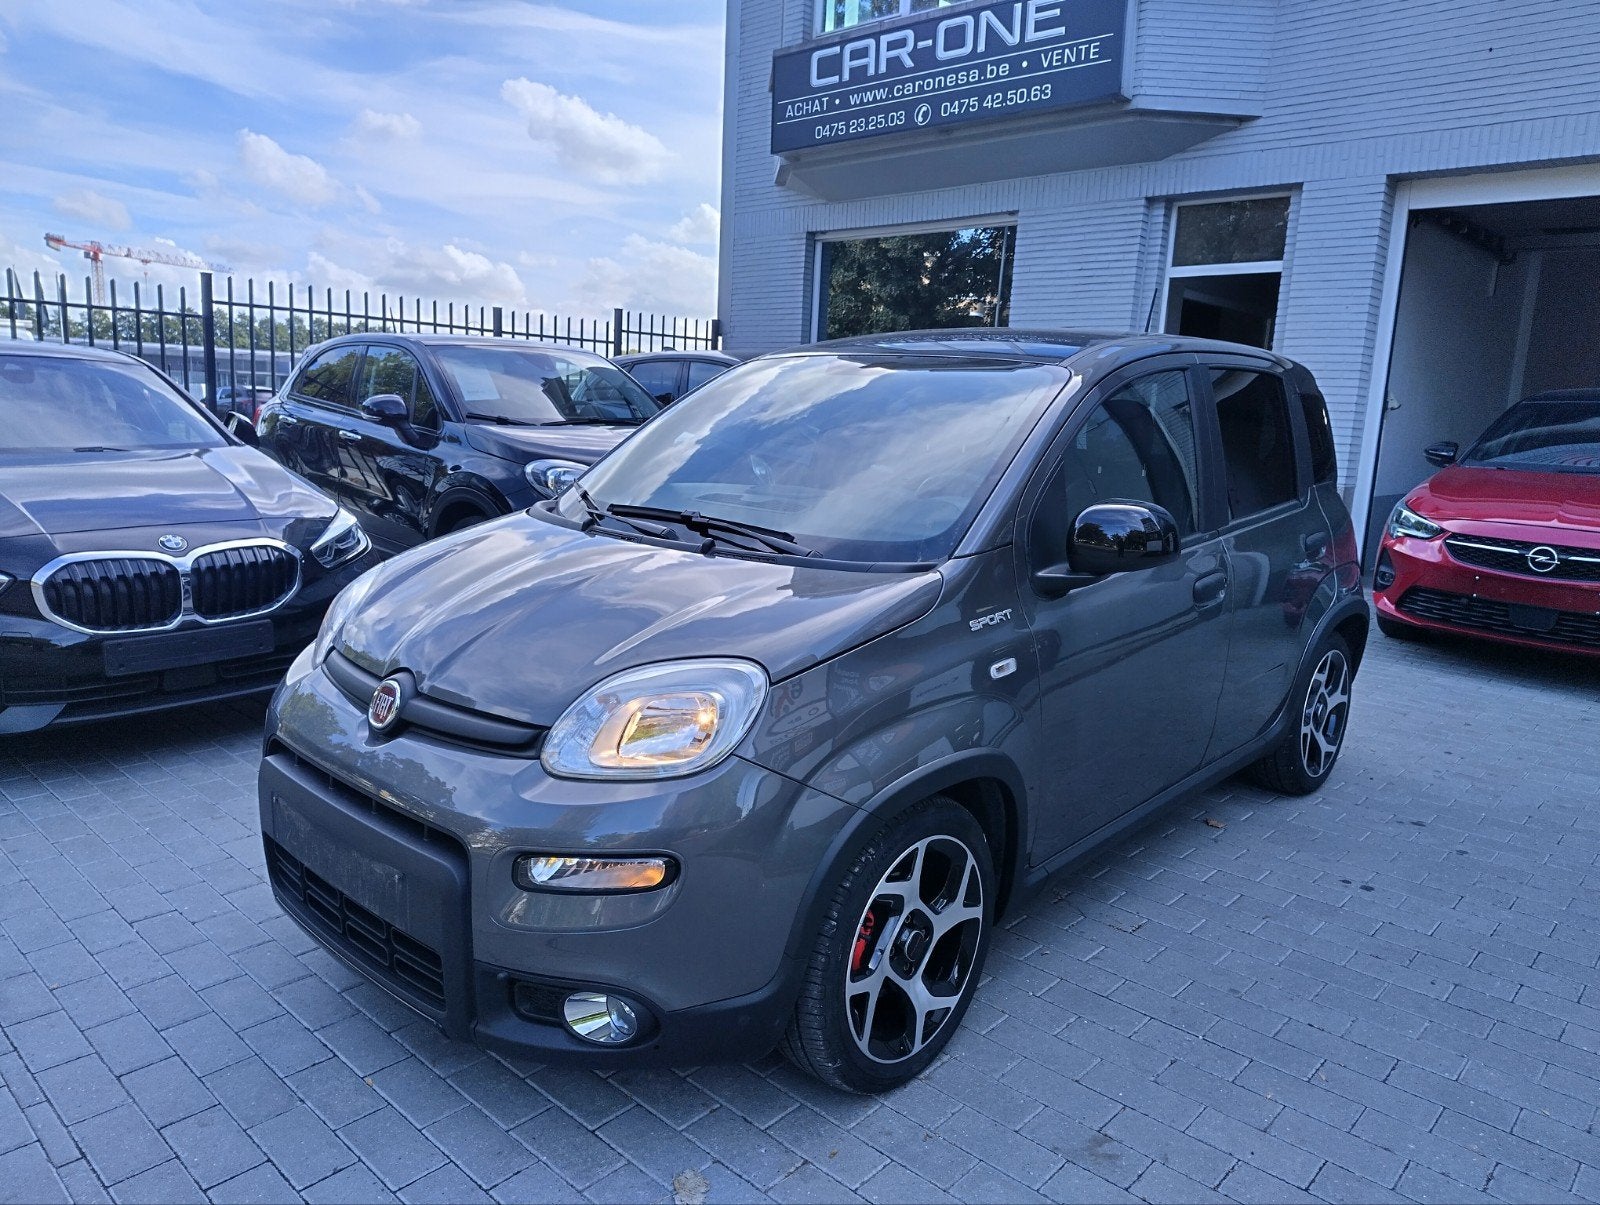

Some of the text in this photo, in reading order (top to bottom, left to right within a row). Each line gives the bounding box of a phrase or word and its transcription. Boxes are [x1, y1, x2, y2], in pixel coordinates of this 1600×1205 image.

[809, 0, 1067, 88] CAR-ONE
[784, 42, 1100, 118] ACHAT www.caronesa.be VENTE
[815, 83, 1052, 139] 0475 23.25.03 0475 42.50.63
[969, 608, 1012, 632] SPORT
[372, 692, 395, 719] FIAT
